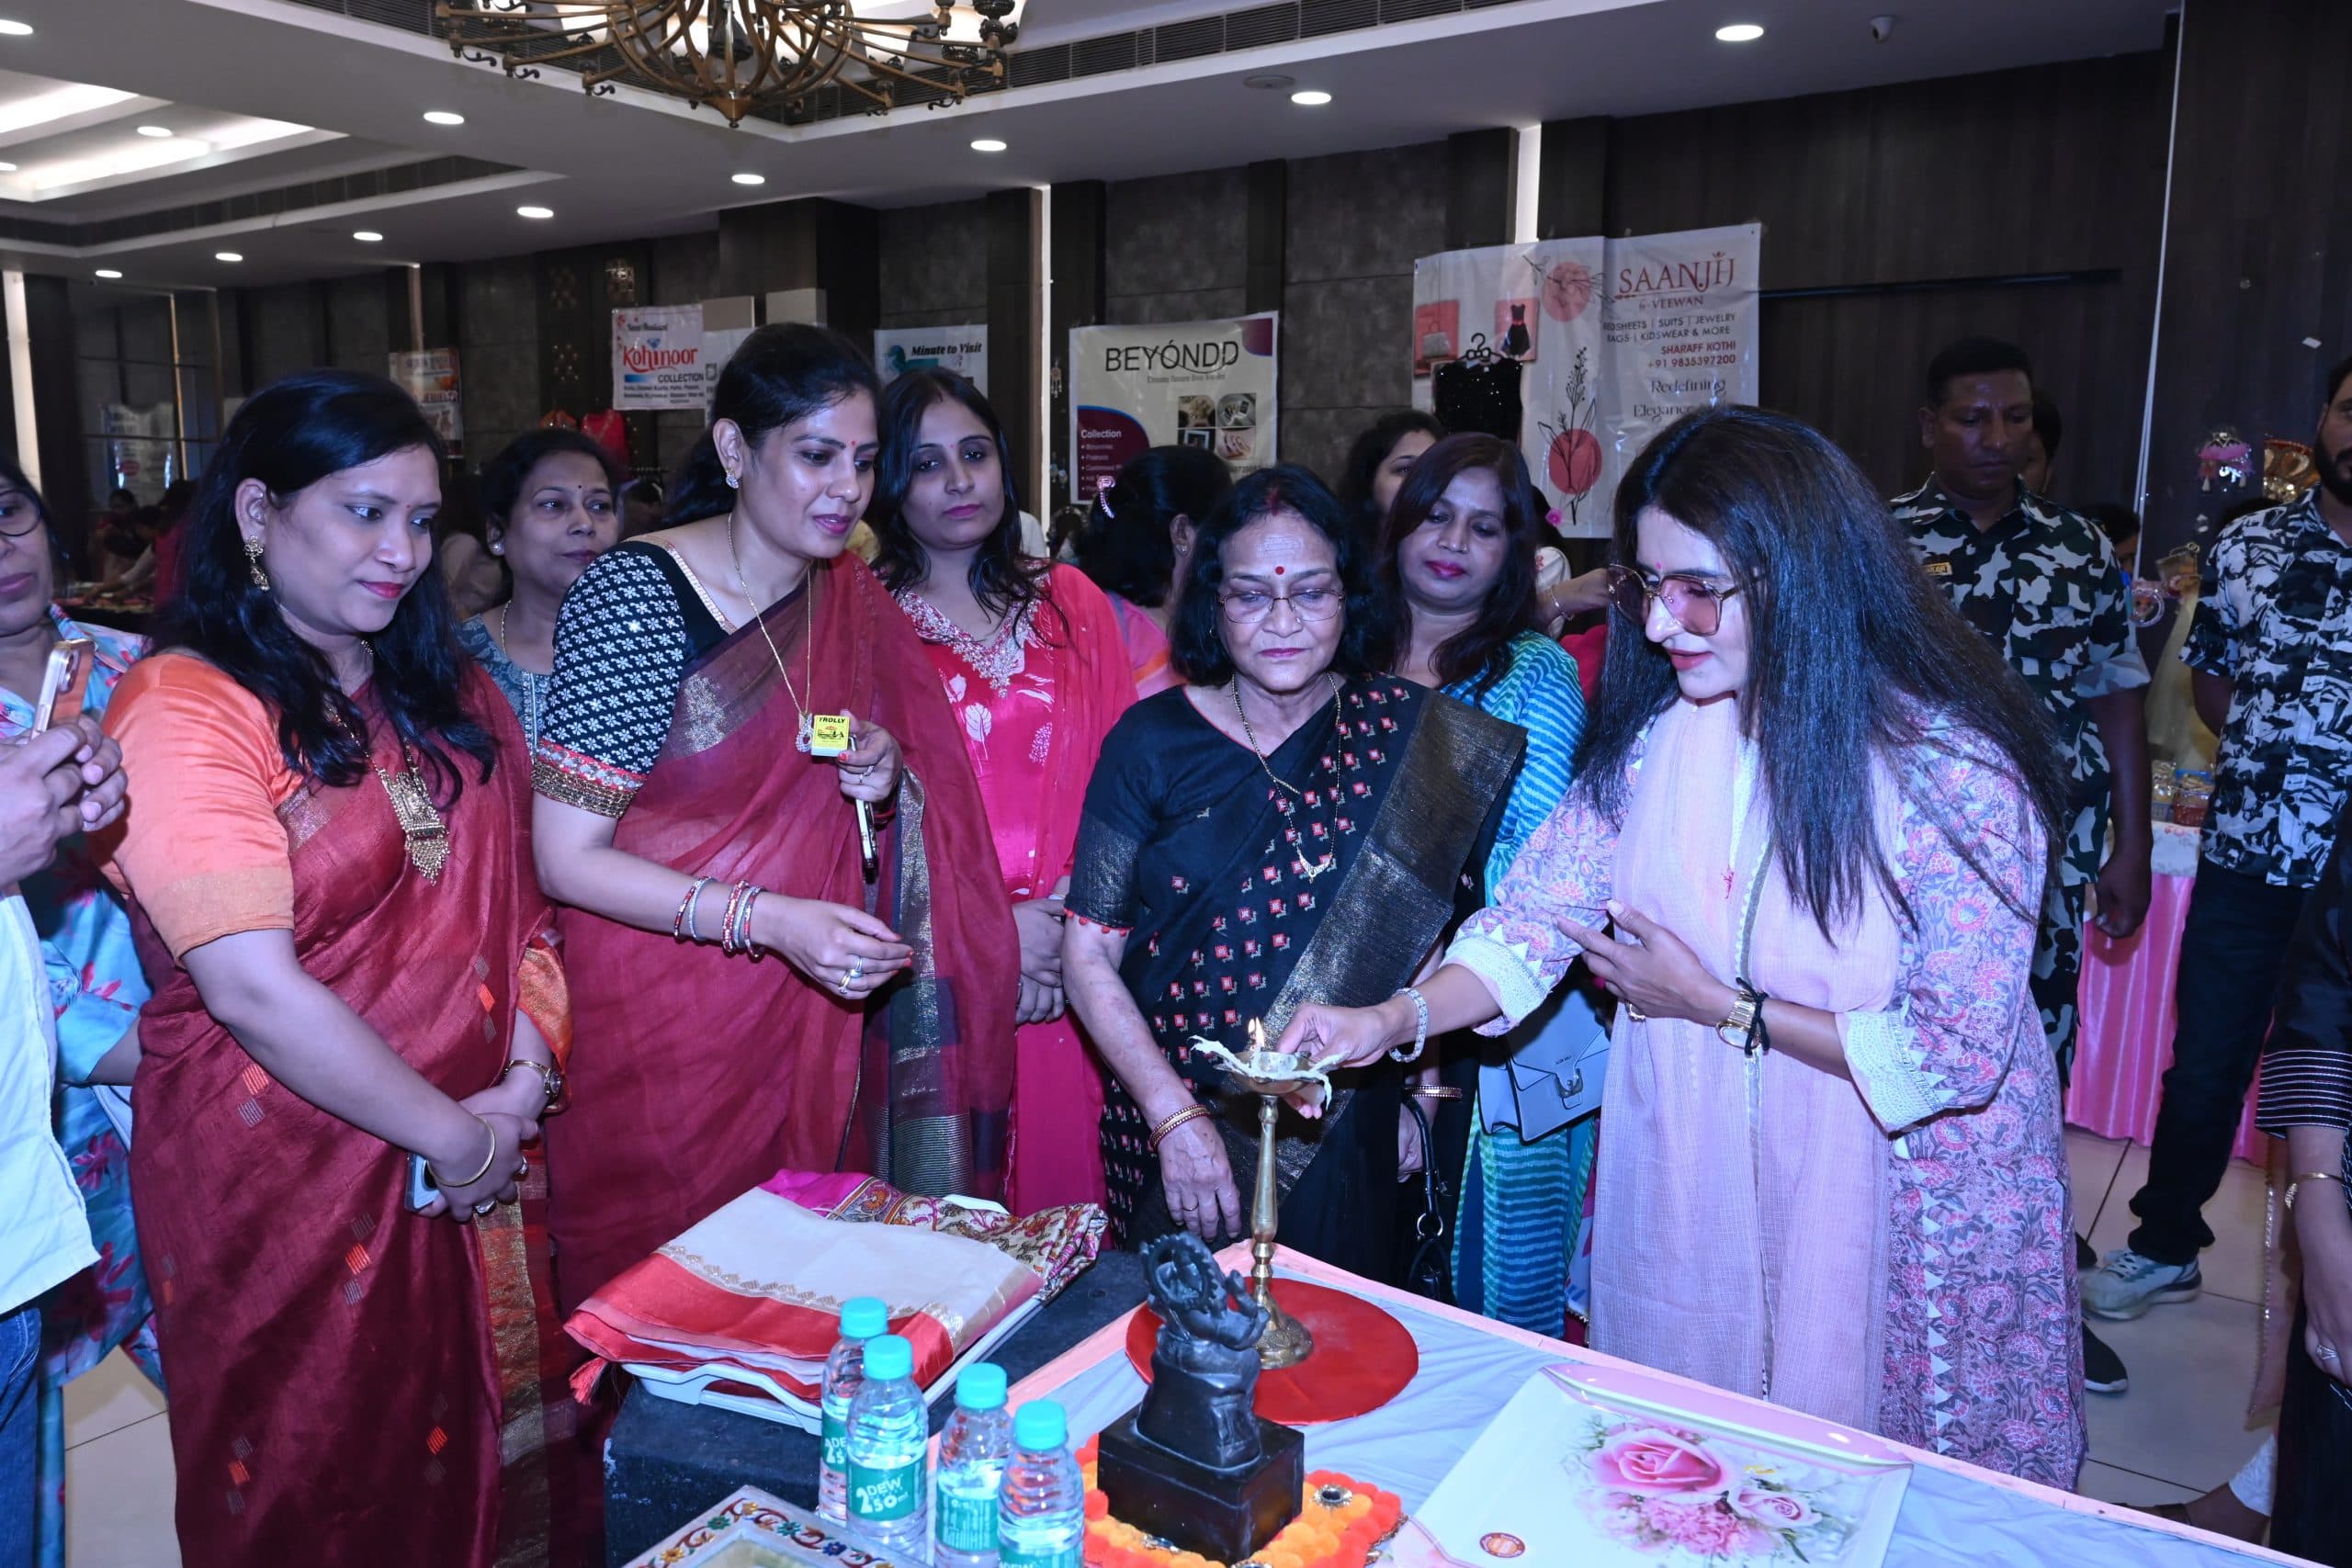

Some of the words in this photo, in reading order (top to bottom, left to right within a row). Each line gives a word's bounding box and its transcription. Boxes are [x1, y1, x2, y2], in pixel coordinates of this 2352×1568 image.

[1653, 296, 1704, 310] VEEWAN
[1658, 317, 1684, 328] SUITS
[1696, 313, 1736, 324] JEWELRY
[1641, 330, 1689, 341] KIDSWEAR
[1692, 328, 1699, 337] &
[1702, 325, 1730, 336] MORE
[910, 344, 945, 356] Minute
[947, 344, 957, 355] to
[959, 341, 983, 354] Visit
[1661, 343, 1704, 355] SHARAFF
[1707, 341, 1736, 352] KOTHI
[623, 345, 698, 373] Kohinoor
[1672, 355, 1736, 368] 9835397200
[658, 373, 705, 383] COLLECTION
[1651, 378, 1726, 397] Redefining
[1080, 428, 1122, 439] Collection
[831, 1438, 846, 1448] DE
[866, 1476, 901, 1496] DEW
